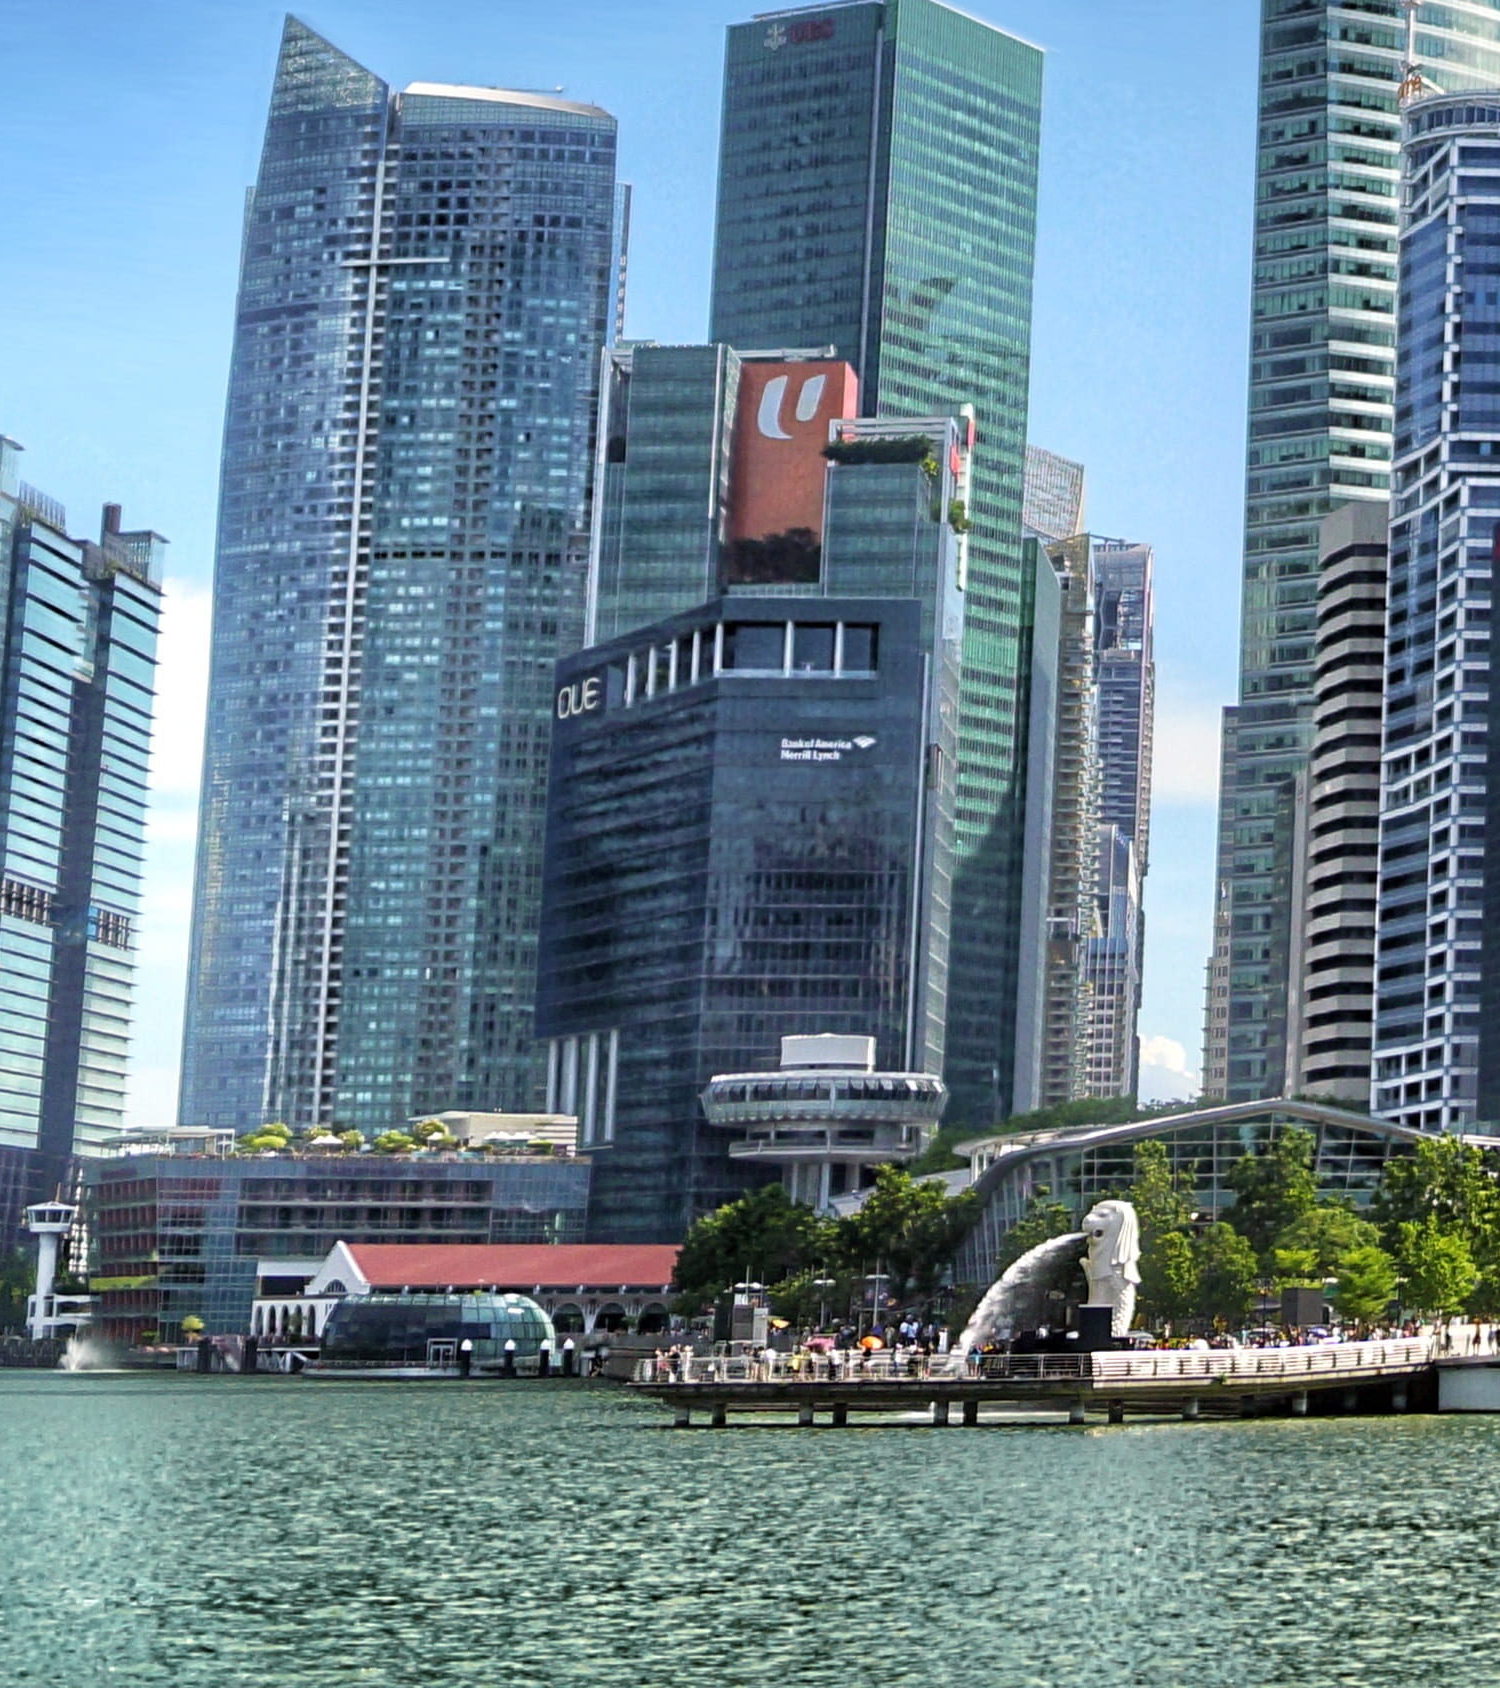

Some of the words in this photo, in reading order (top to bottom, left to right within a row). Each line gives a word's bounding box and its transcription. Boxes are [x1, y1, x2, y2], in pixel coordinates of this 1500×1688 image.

[558, 676, 601, 720] OUE
[815, 738, 852, 750] America
[781, 749, 811, 760] Merrill
[813, 750, 840, 761] Lynch
